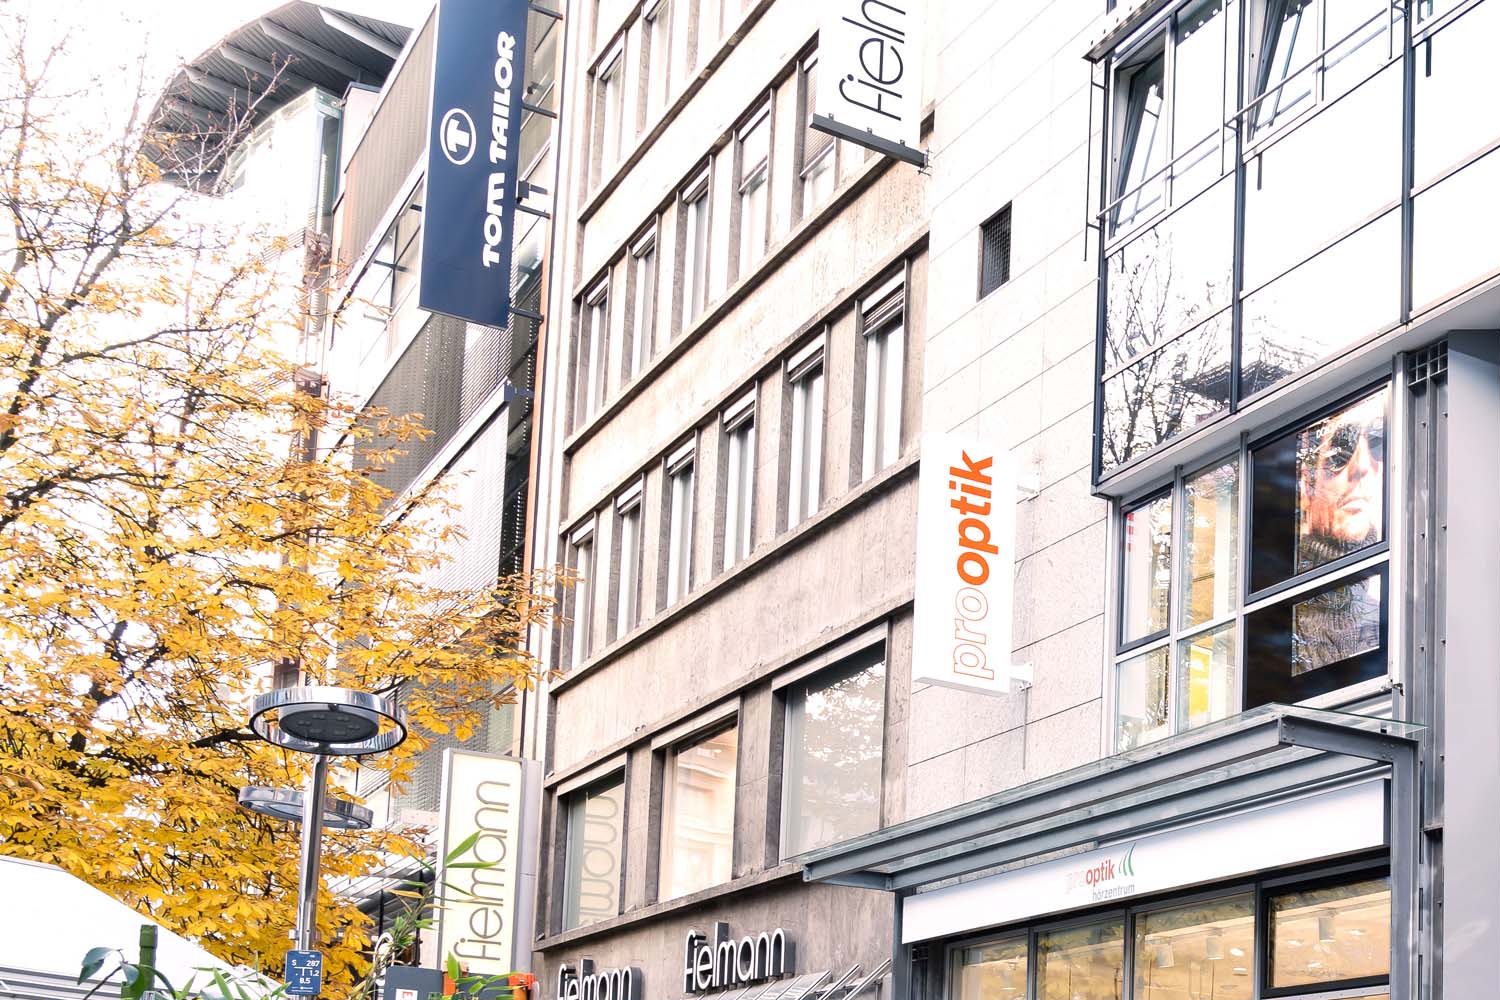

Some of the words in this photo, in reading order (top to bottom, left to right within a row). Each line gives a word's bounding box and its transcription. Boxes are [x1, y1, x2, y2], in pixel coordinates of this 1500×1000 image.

[490, 31, 516, 164] TAILOR
[482, 171, 506, 268] TOM
[949, 449, 999, 680] prooptik
[453, 780, 511, 961] fielmann
[684, 922, 790, 993] fielmann
